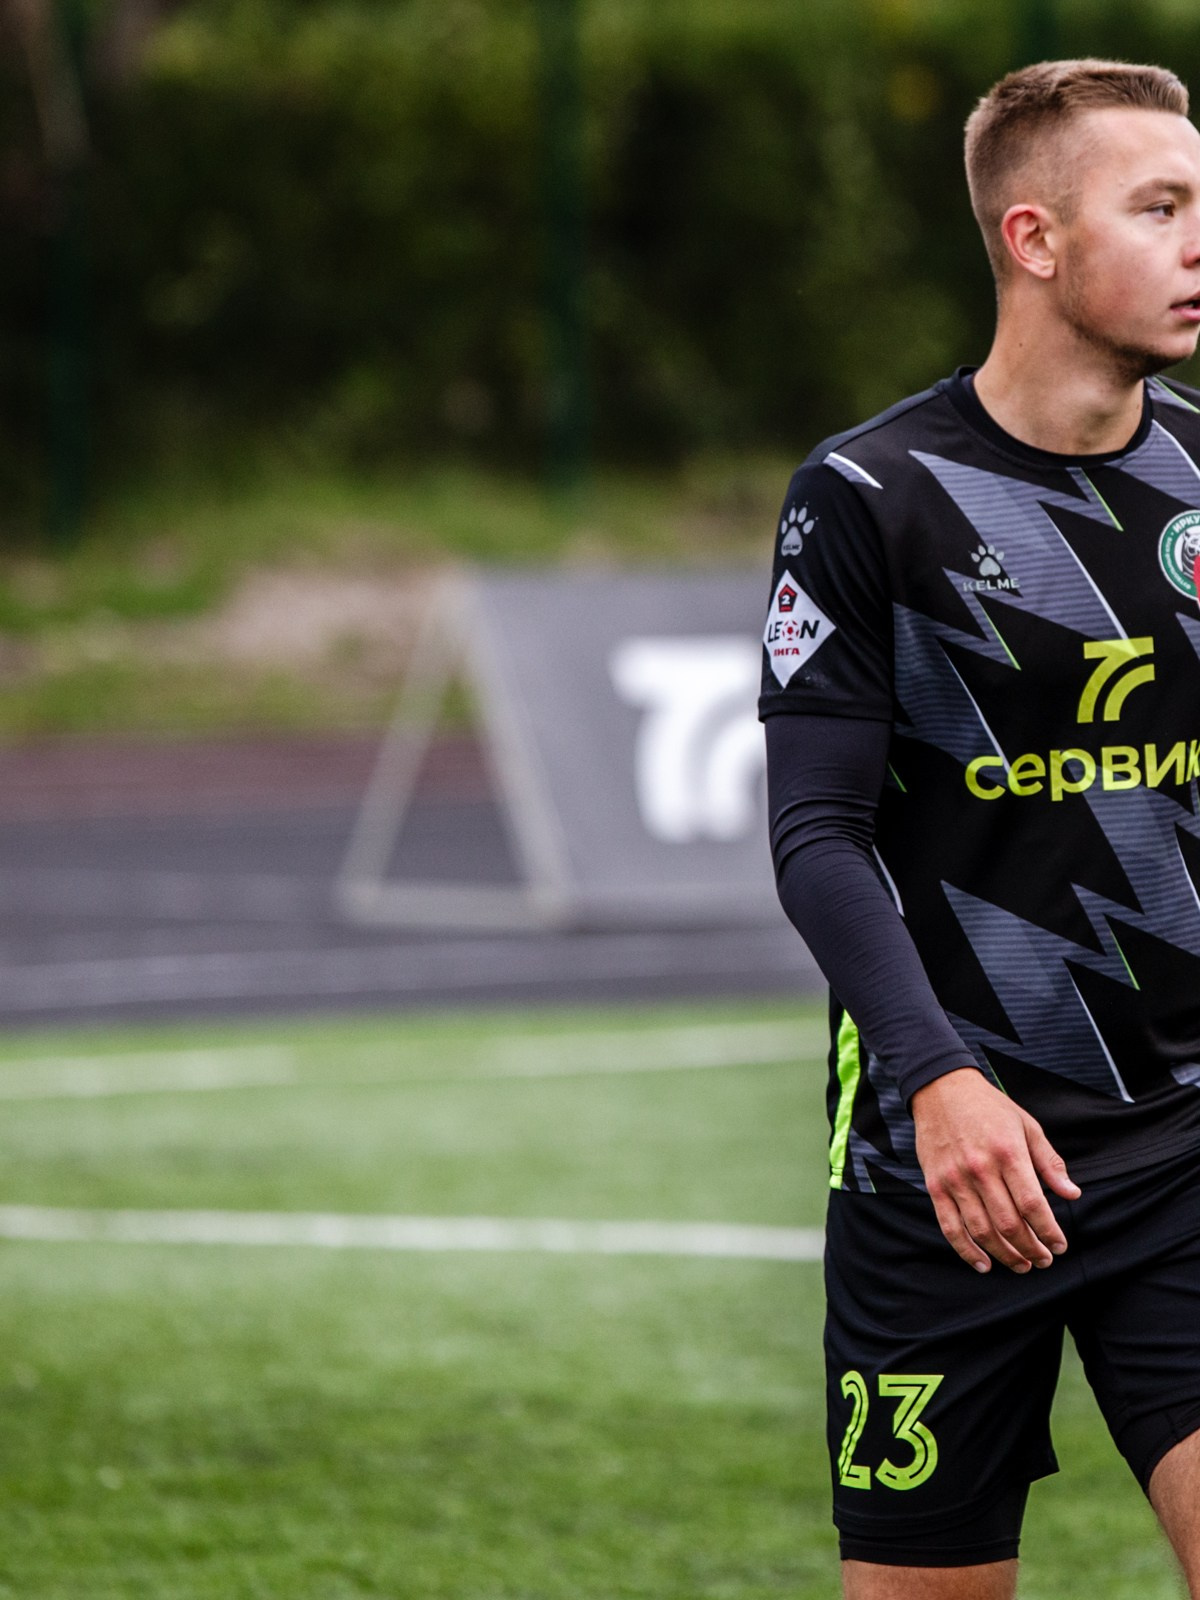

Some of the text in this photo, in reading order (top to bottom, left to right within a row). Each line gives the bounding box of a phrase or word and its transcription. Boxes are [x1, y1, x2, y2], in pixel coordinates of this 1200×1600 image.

[962, 577, 1021, 592] KELME
[782, 595, 790, 604] 2
[837, 1370, 945, 1491] 23
